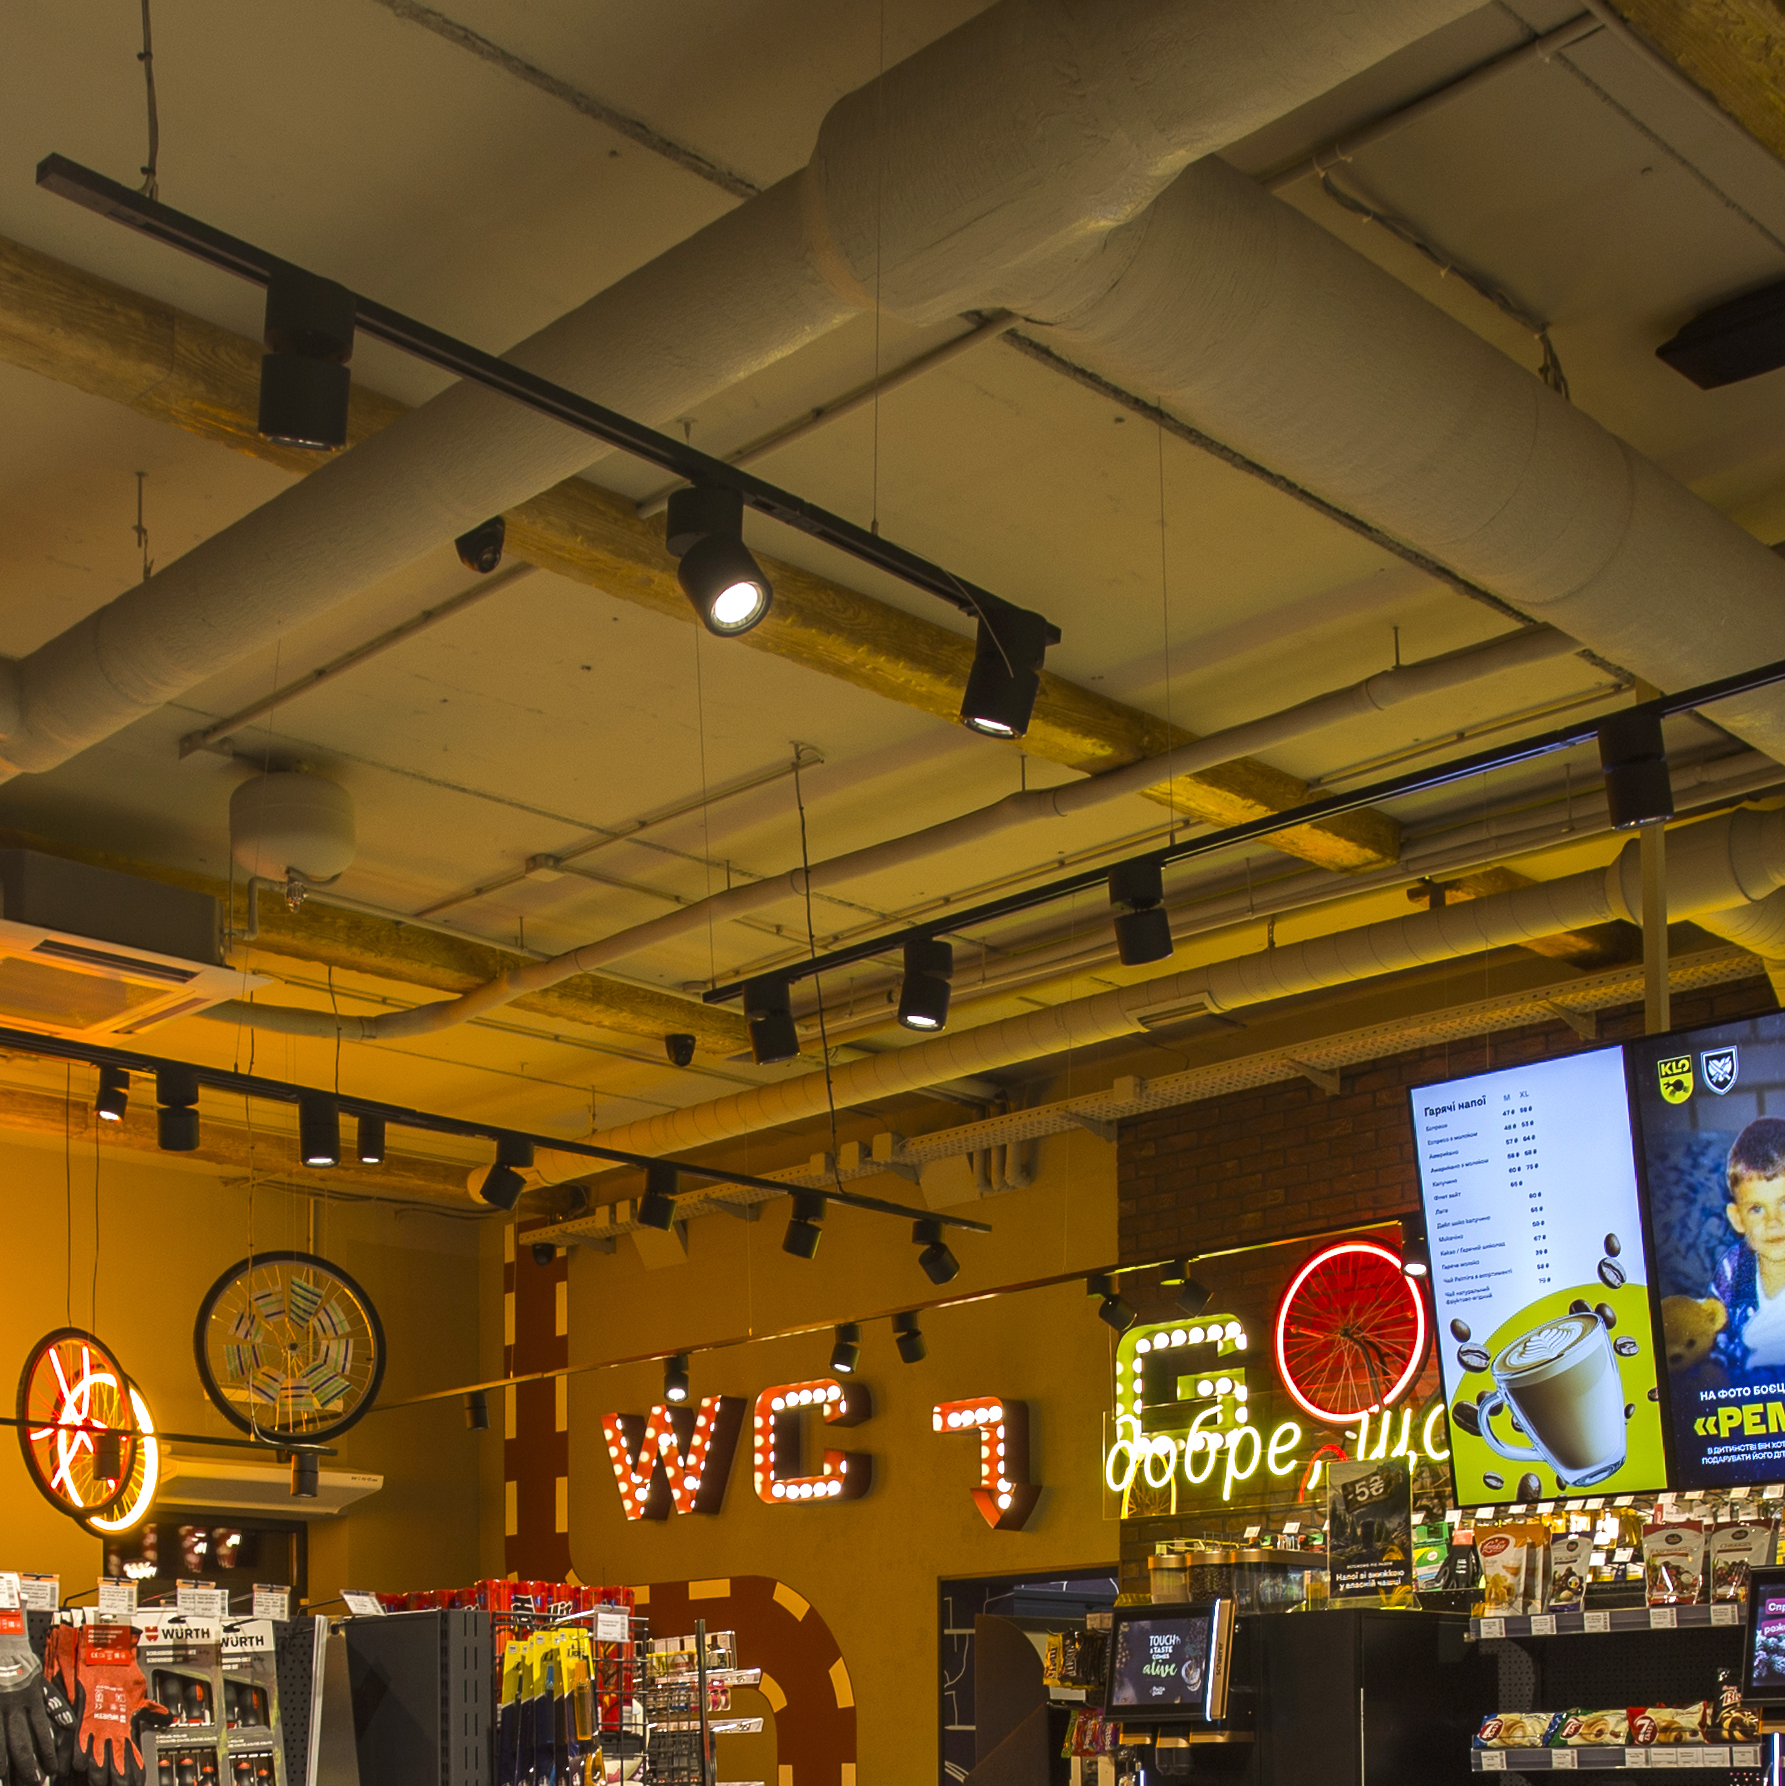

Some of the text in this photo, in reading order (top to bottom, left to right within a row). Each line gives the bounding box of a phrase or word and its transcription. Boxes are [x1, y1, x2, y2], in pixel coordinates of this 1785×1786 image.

[1660, 1059, 1690, 1076] KLO
[1424, 1095, 1487, 1117] Гарячі напої
[1700, 1390, 1716, 1401] НА
[1717, 1385, 1751, 1400] ФОТО
[601, 1378, 871, 1521] WC
[162, 1627, 210, 1641] WÜRTH
[1149, 1635, 1176, 1647] TOUCH
[1142, 1659, 1178, 1678] alive
